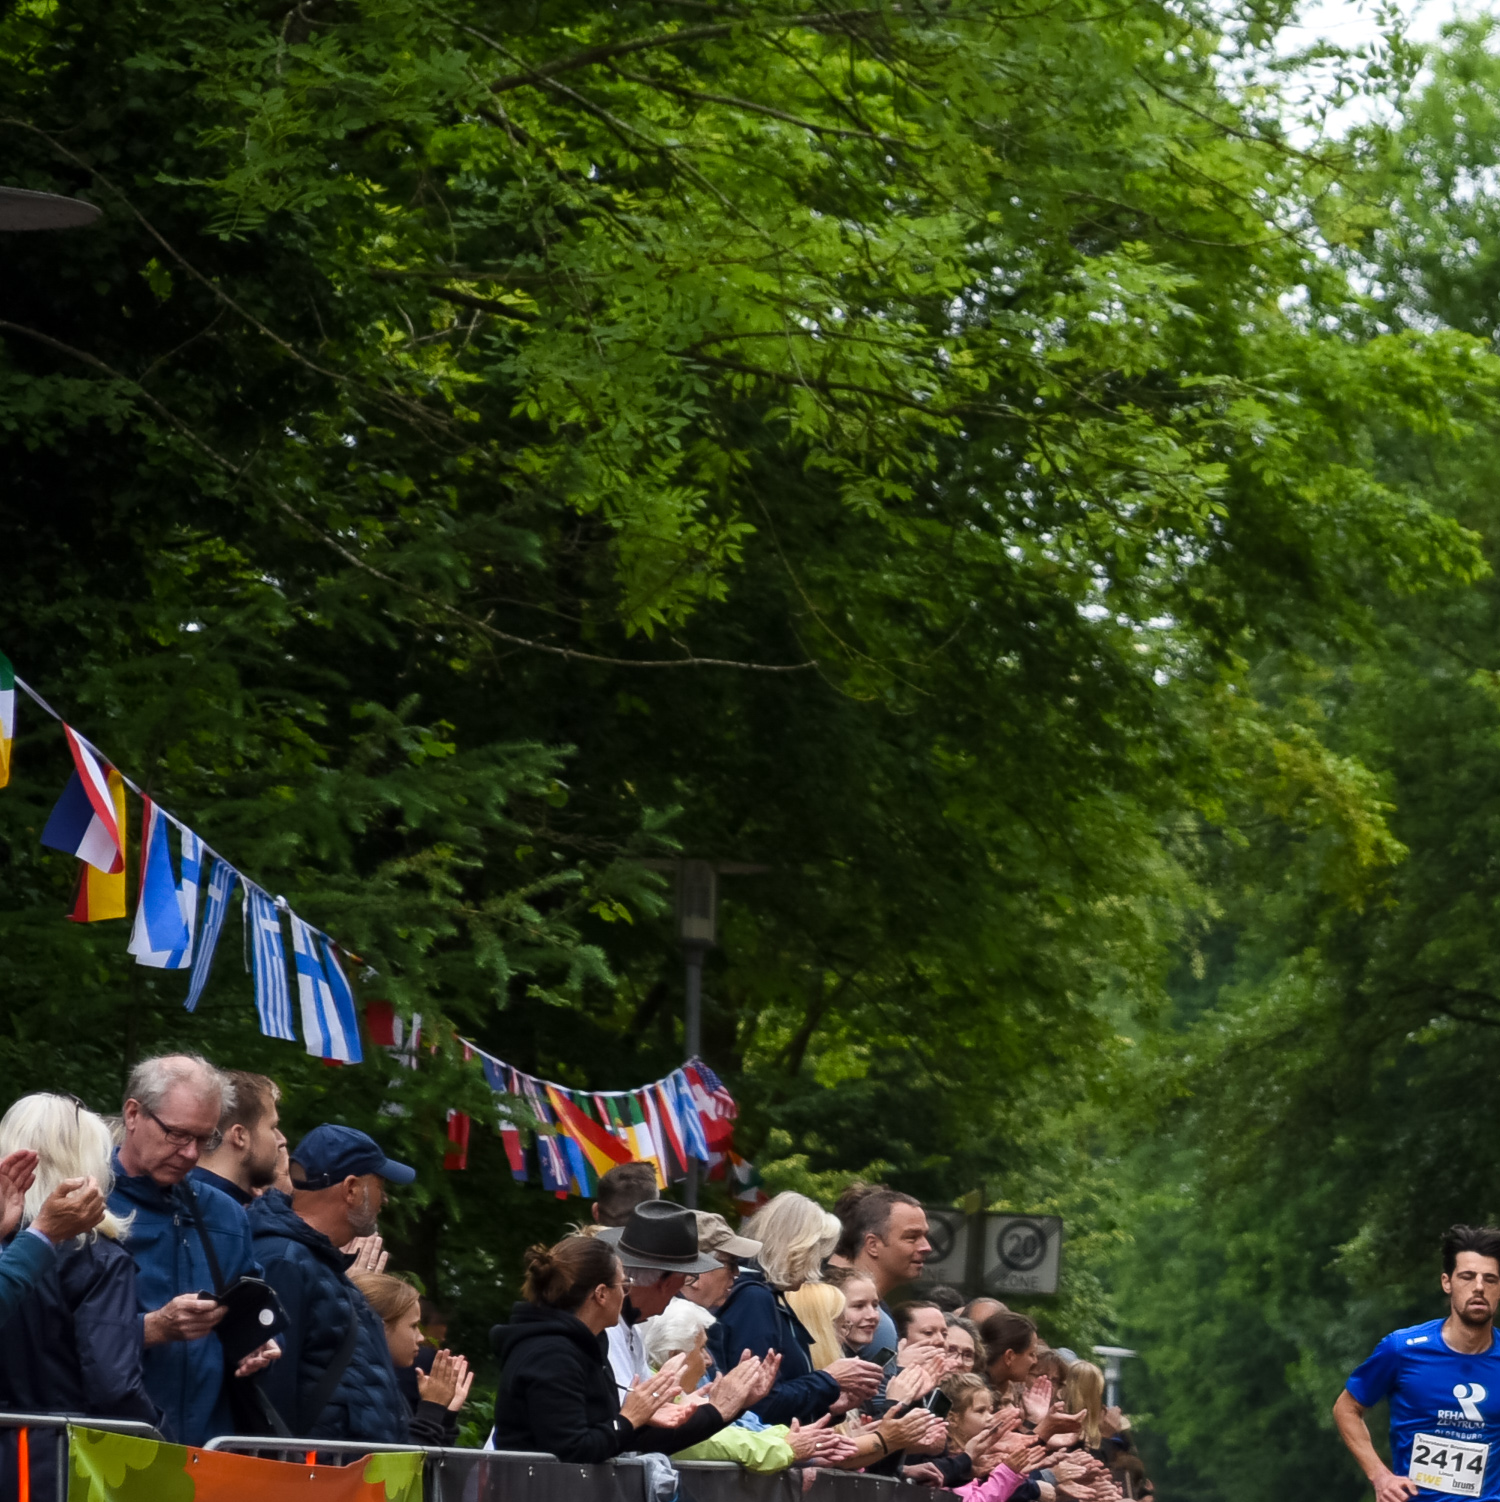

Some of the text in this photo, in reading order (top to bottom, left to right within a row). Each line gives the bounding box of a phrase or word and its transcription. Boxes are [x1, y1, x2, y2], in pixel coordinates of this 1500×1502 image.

[1009, 1232, 1037, 1257] 20
[1437, 1409, 1465, 1421] REHA
[1436, 1418, 1486, 1430] ZENTRUM
[1413, 1444, 1483, 1475] 2414
[1415, 1472, 1443, 1487] EWE
[1451, 1478, 1476, 1491] bruns
